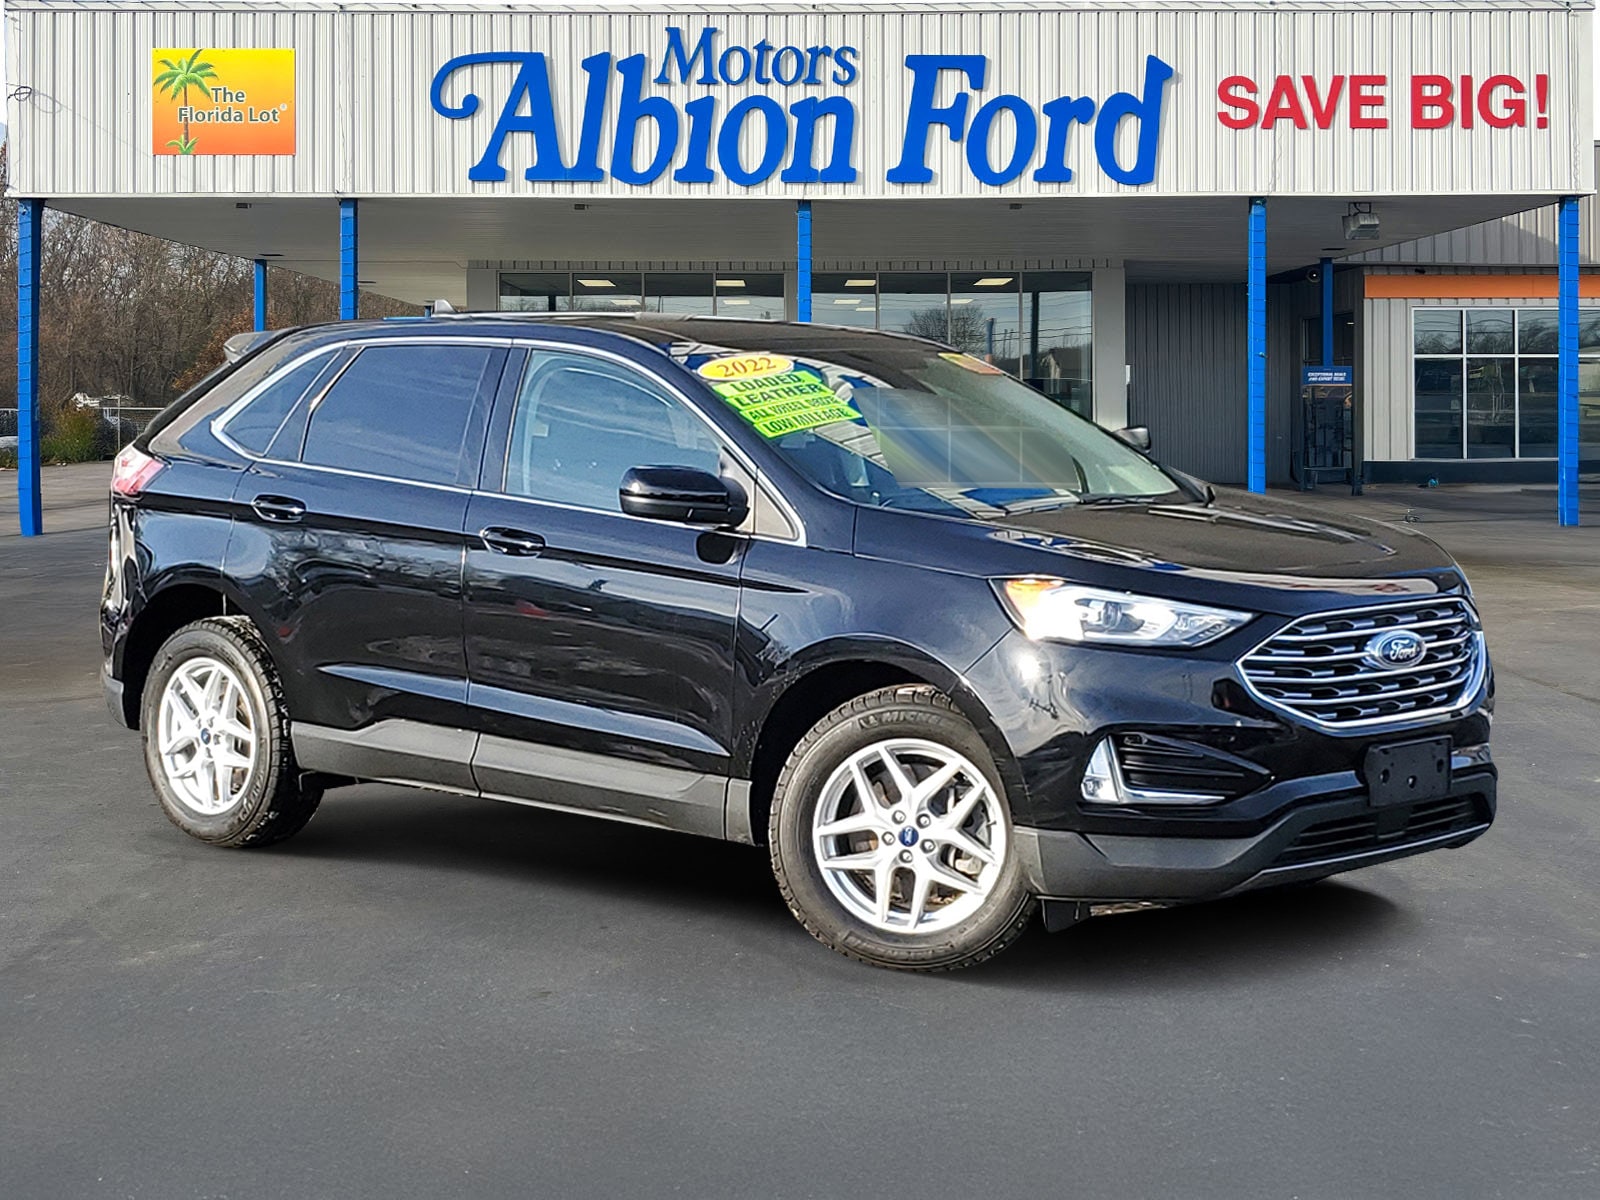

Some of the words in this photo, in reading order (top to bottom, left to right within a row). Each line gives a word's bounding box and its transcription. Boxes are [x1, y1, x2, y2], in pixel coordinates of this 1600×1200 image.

[654, 28, 858, 86] Motors
[211, 86, 246, 103] The
[1217, 74, 1389, 129] SAVE
[1411, 74, 1549, 130] BIG!
[178, 106, 244, 123] Florida
[430, 51, 857, 186] Albion
[886, 55, 1175, 187] Ford
[716, 356, 777, 377] 2022
[734, 383, 823, 407] LEATHER
[763, 418, 794, 434] LOW
[794, 407, 851, 426] MILEAGE
[1391, 638, 1417, 660] Ford
